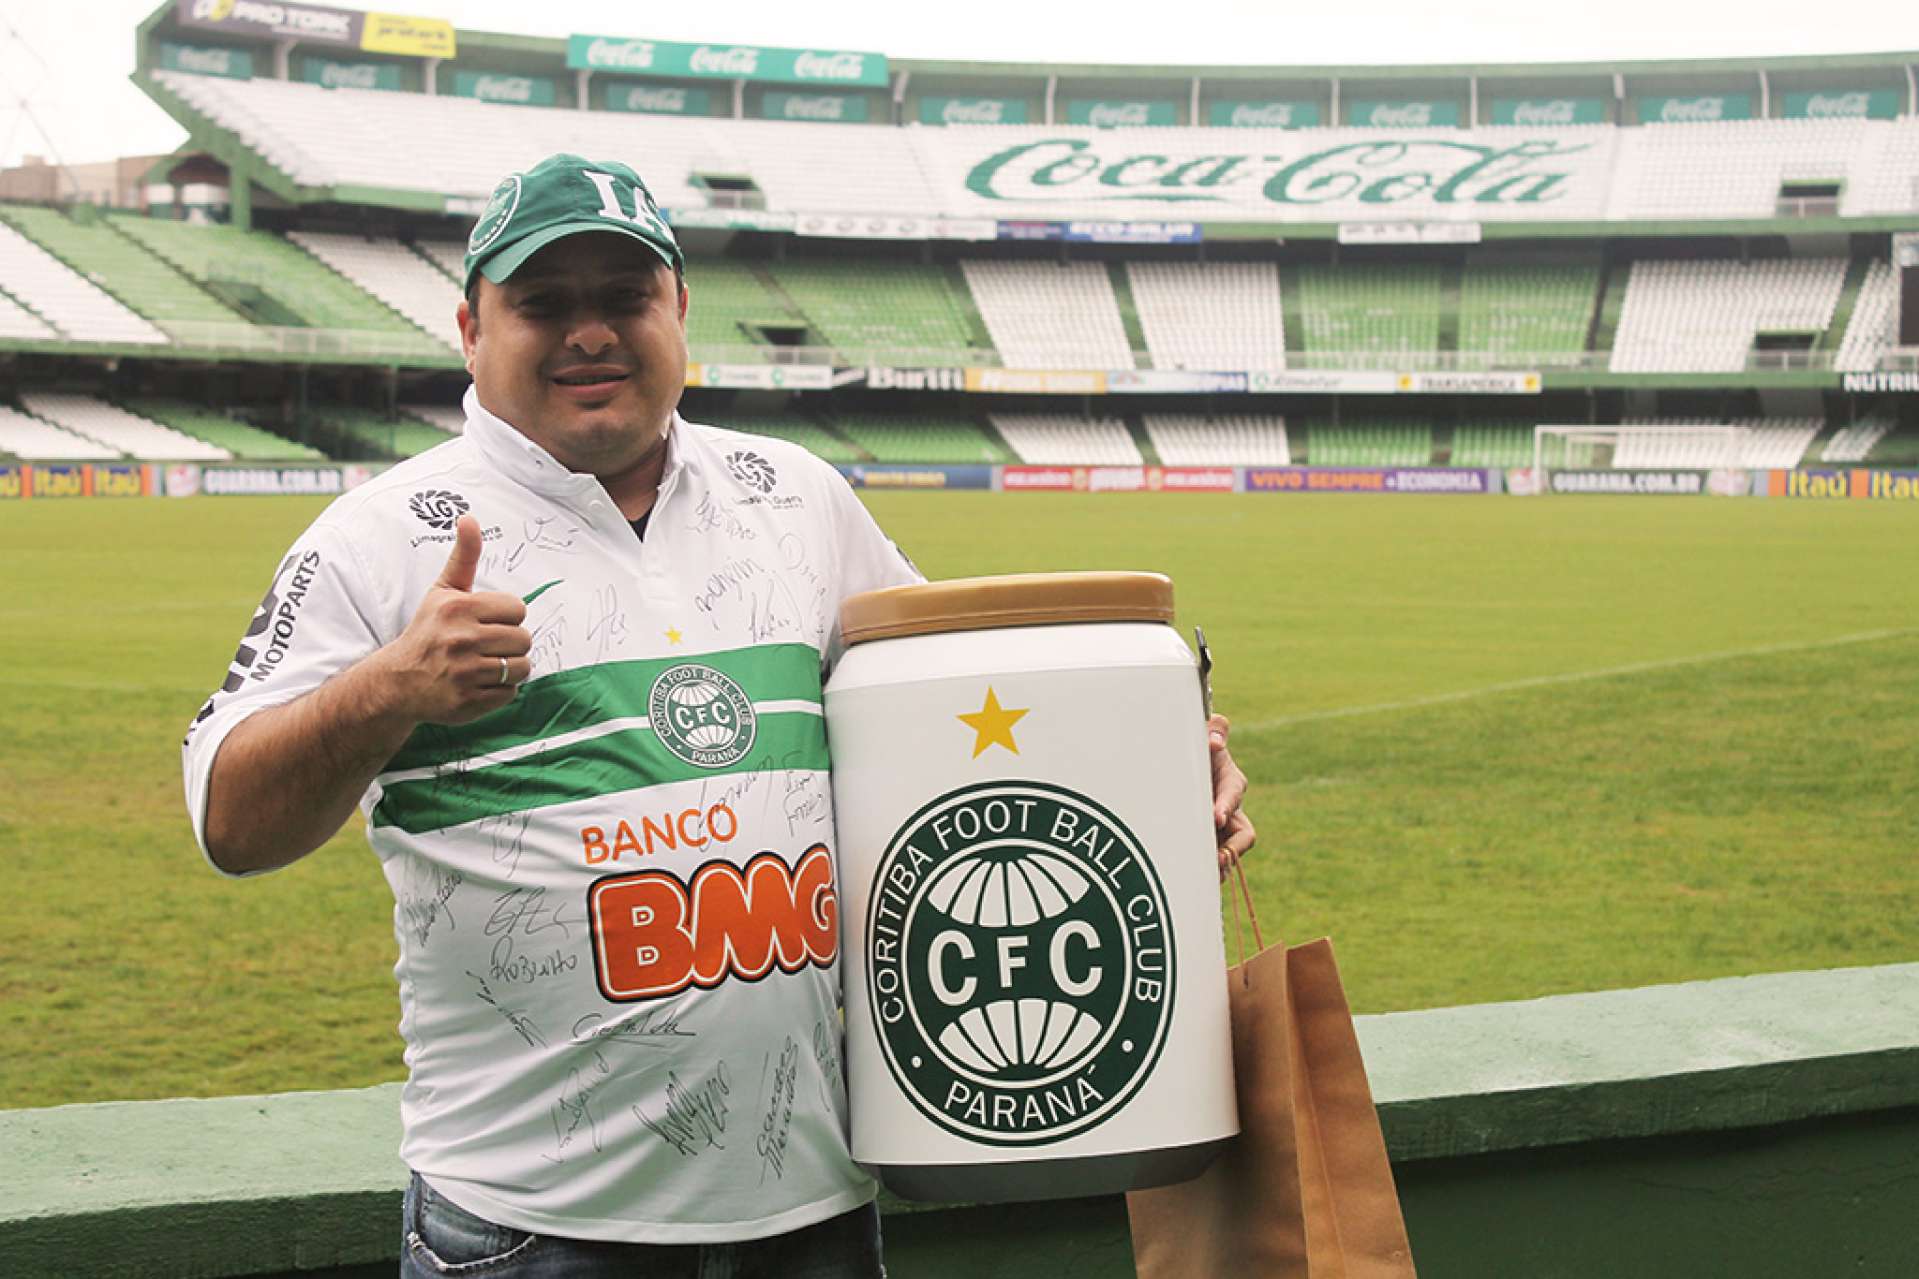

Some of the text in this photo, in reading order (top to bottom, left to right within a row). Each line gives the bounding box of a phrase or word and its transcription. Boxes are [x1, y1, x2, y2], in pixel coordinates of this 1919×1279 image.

[1252, 470, 1302, 489] VIVO
[250, 549, 321, 683] MOTOPARTS
[665, 667, 698, 685] FOOT
[674, 701, 732, 730] CFC
[579, 802, 738, 866] BANCO
[586, 842, 838, 1004] BMG
[875, 843, 934, 1024] CORITIBA
[931, 799, 1038, 852] FOOT
[1049, 806, 1132, 890] BALL
[1126, 893, 1164, 1004] CLUB
[926, 919, 1104, 1007] CFC
[943, 1062, 1105, 1129] PARANÁ
